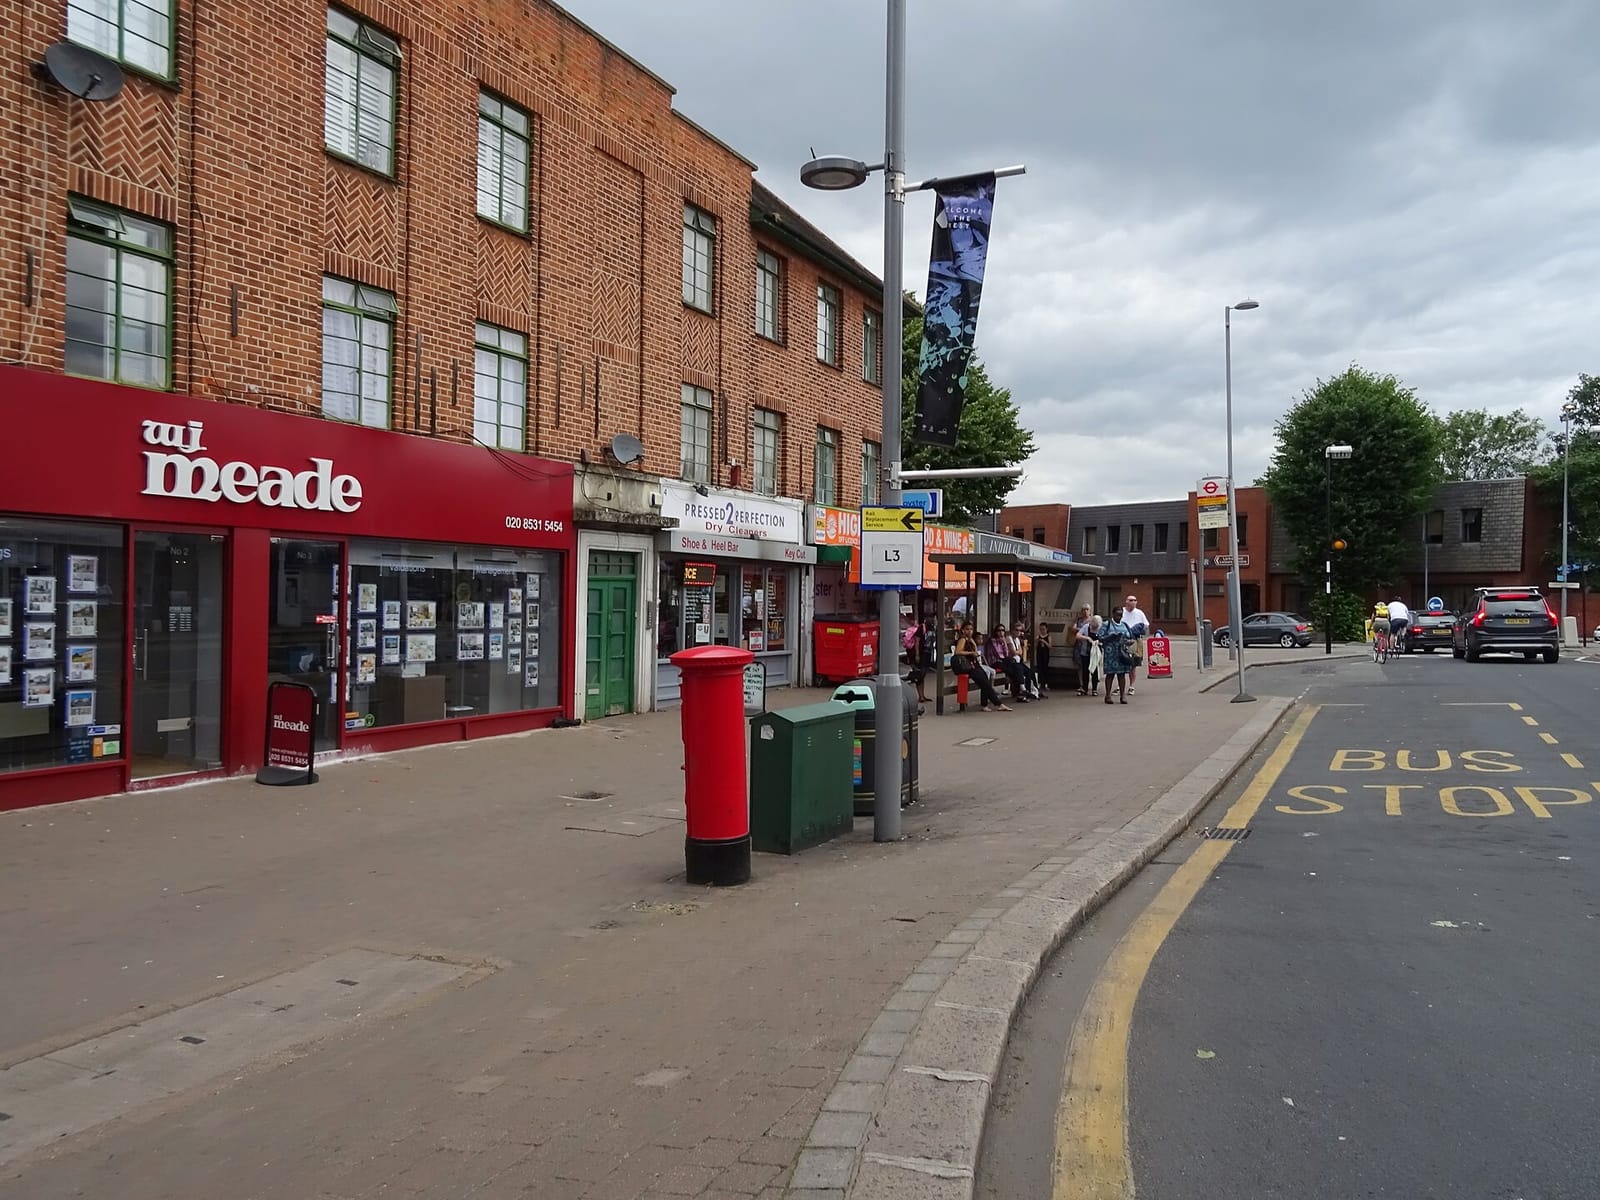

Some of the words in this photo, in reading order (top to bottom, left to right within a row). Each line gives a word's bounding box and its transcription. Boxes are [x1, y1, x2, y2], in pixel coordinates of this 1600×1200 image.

[140, 450, 363, 513] meade
[684, 503, 726, 521] PRESSED
[725, 502, 734, 525] 2
[735, 510, 785, 528] PERFECTION
[505, 516, 522, 529] 020
[523, 518, 542, 531] 8531
[544, 520, 563, 533] 5454
[705, 521, 724, 533] Dry
[728, 525, 768, 538] Cleaners
[838, 511, 861, 537] HIG
[681, 536, 701, 549] Shoe
[701, 539, 707, 550] &
[711, 539, 727, 551] Heel
[727, 541, 739, 553] Bar
[935, 528, 942, 548] &
[944, 530, 962, 551] WINE
[784, 548, 796, 560] Key
[796, 549, 806, 560] Cut
[884, 550, 901, 562] L3
[274, 719, 310, 733] meade
[270, 753, 281, 761] 020
[1329, 749, 1523, 773] BUS
[1275, 784, 1593, 818] STOP
